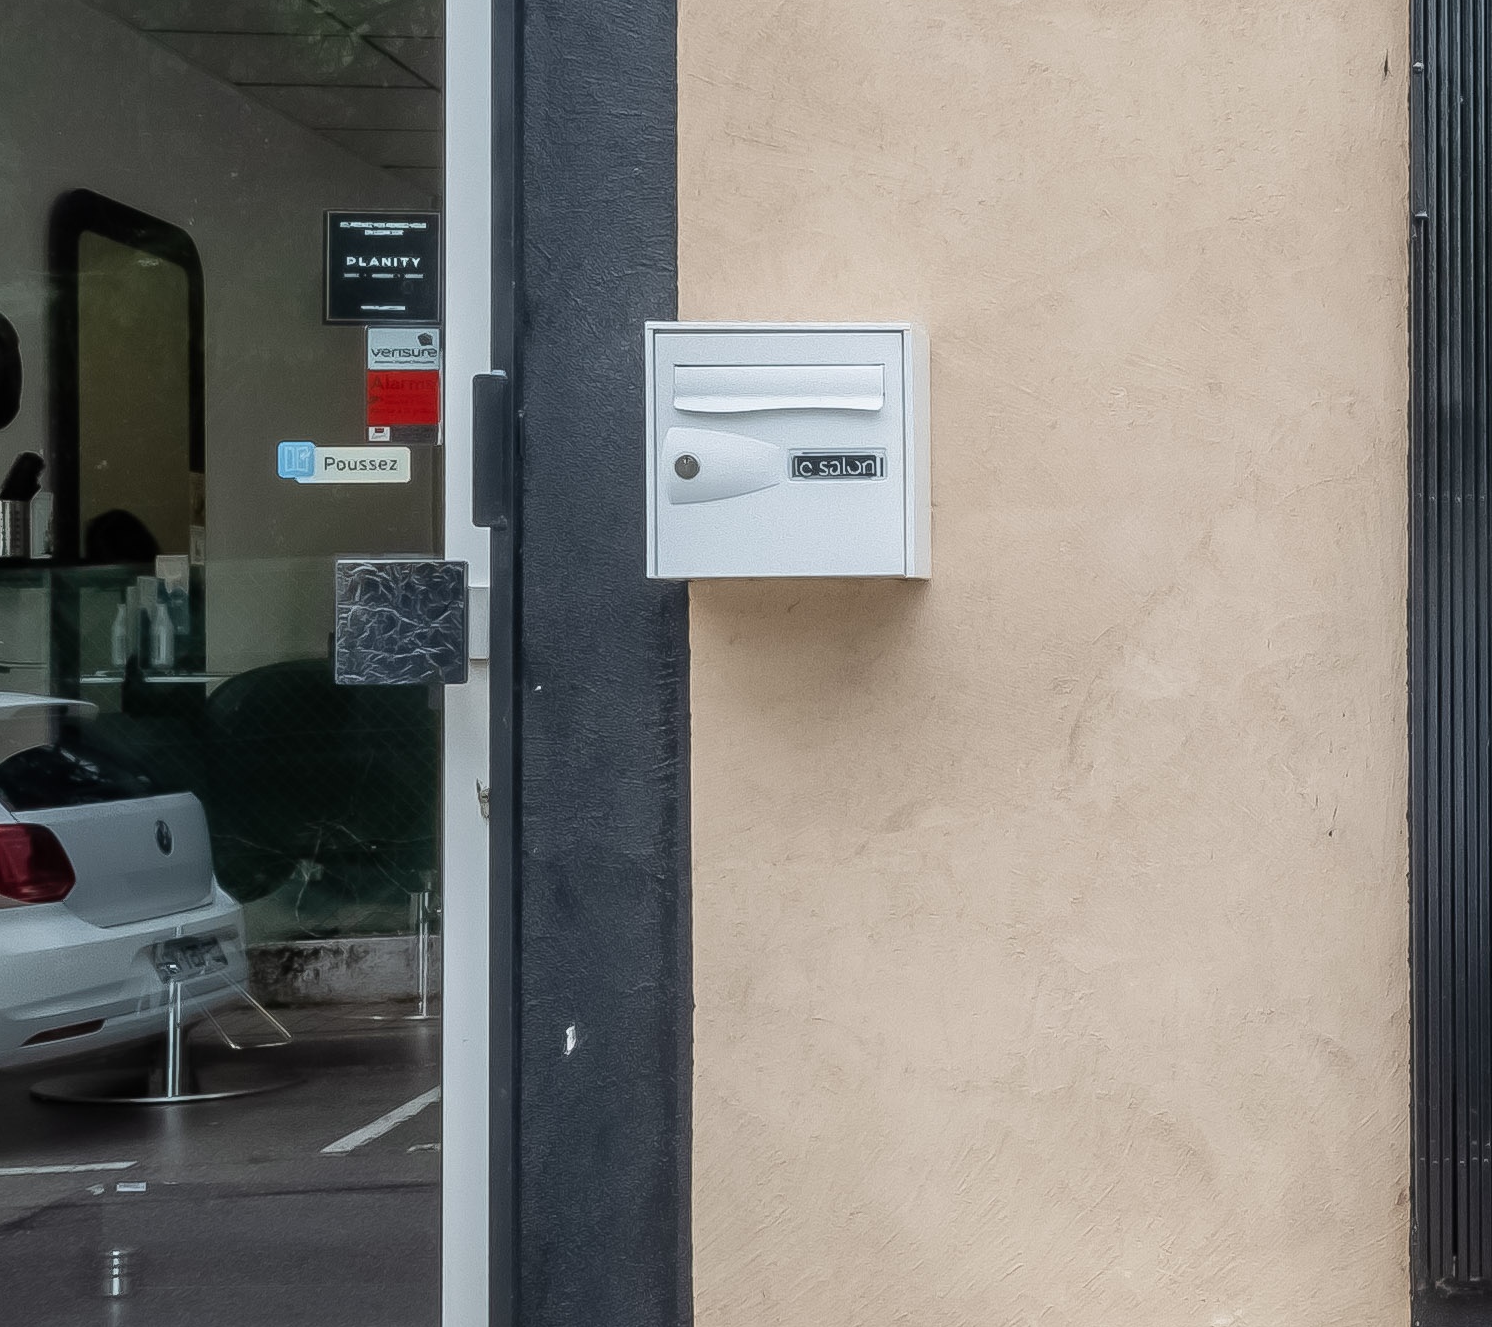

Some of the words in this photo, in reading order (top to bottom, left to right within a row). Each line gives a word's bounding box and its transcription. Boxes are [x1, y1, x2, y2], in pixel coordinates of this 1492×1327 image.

[346, 256, 421, 268] PLANITY
[371, 348, 438, 357] verisure
[324, 456, 398, 471] Poussez
[819, 457, 875, 476] salon
